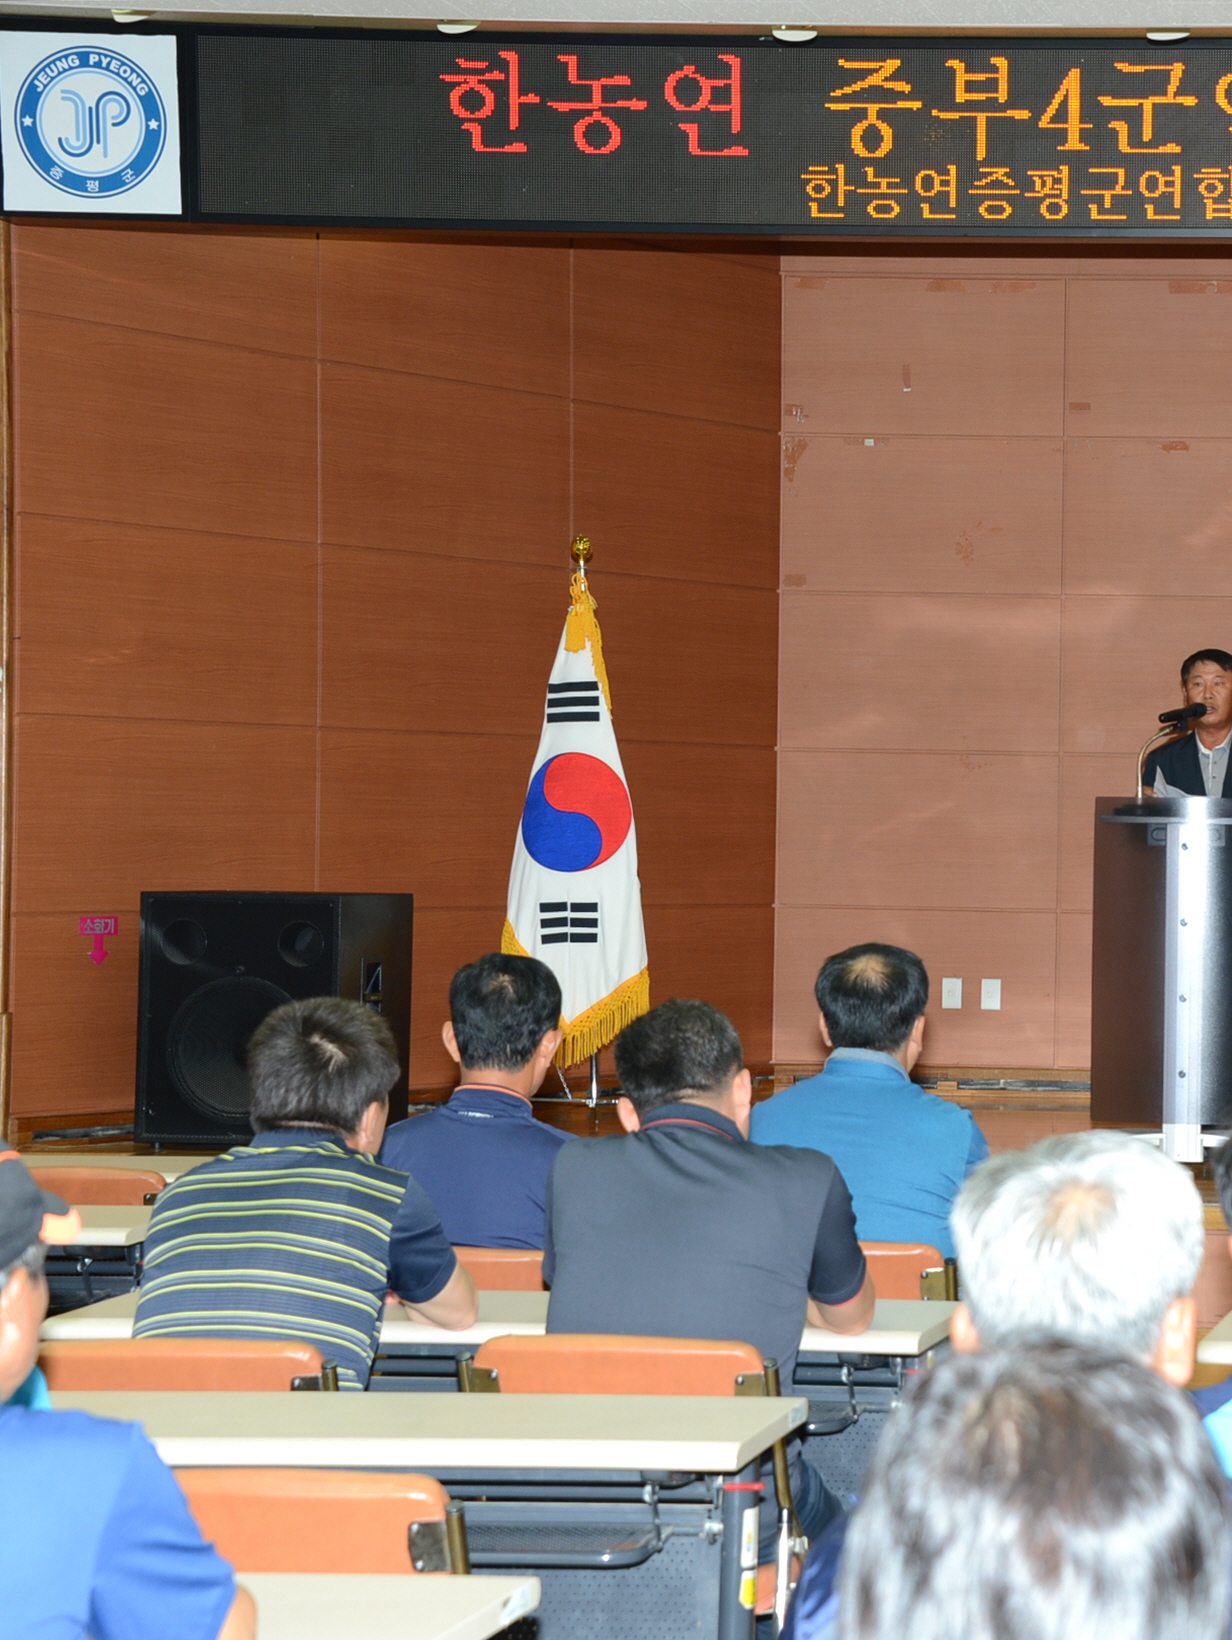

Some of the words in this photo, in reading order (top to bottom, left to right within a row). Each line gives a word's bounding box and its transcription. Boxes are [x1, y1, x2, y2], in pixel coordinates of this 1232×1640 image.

[33, 54, 80, 92] JEUNG
[88, 53, 149, 96] PYEONG
[439, 50, 749, 156] 한농연
[84, 918, 115, 934] 소화기
